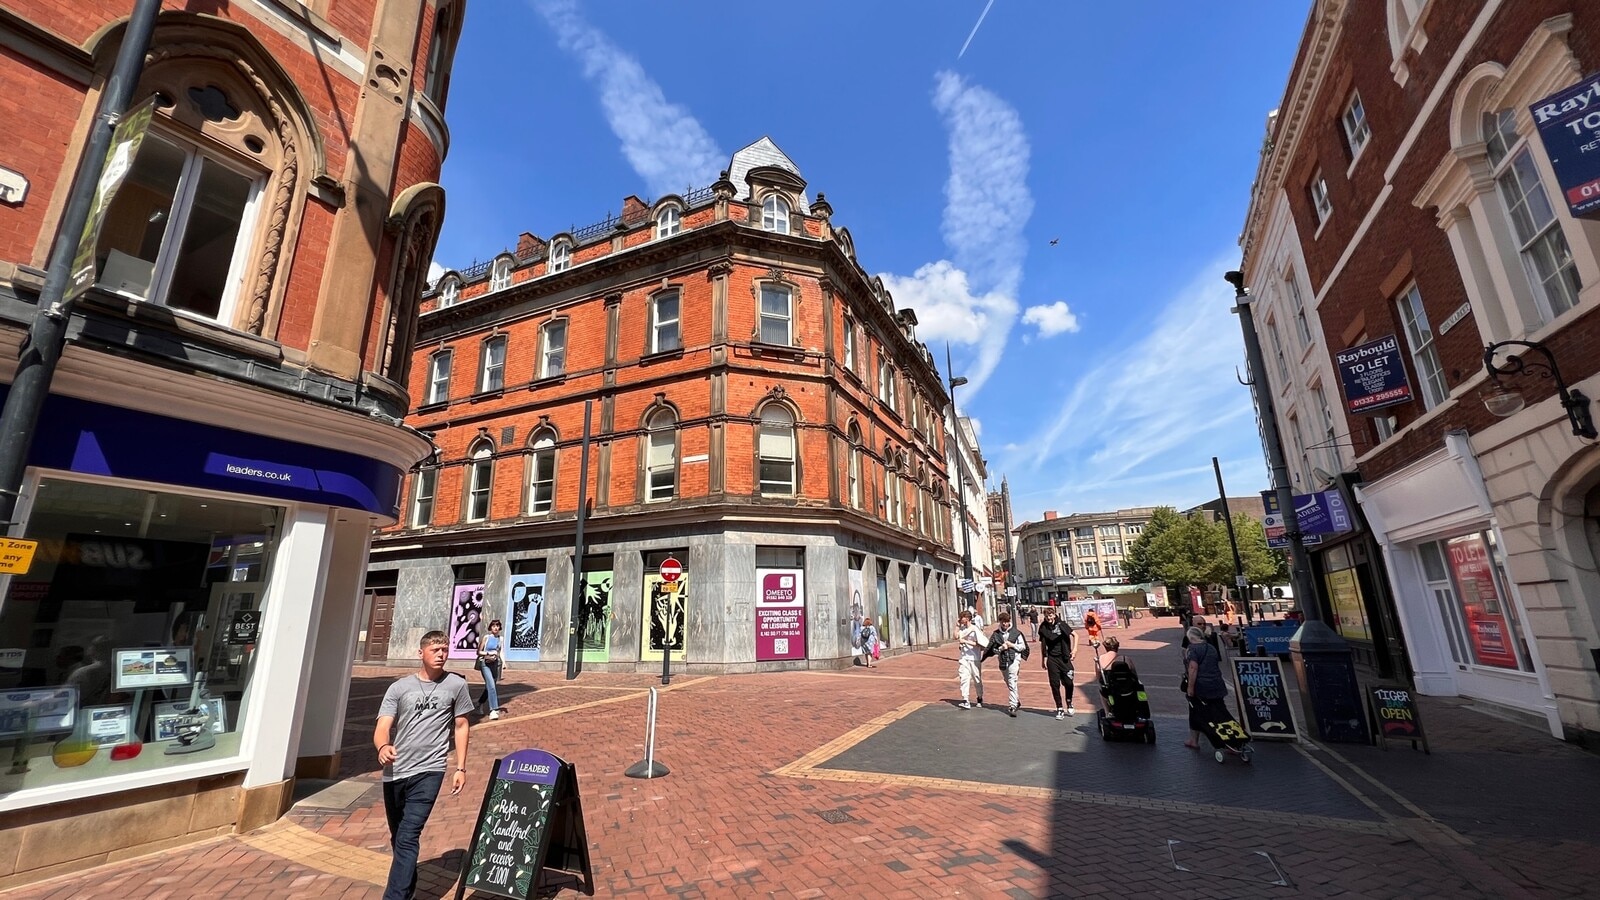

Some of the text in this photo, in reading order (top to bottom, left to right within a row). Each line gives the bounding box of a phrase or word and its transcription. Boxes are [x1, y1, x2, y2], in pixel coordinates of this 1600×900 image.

[1337, 338, 1396, 364] Raybould
[1349, 356, 1389, 375] TO LET
[1354, 396, 1375, 406] 01332
[1376, 389, 1403, 401] 295555
[226, 463, 291, 481] leaders.co.uk
[1297, 504, 1321, 519] ADERS
[1329, 493, 1348, 528] TO LET
[8, 541, 33, 550] Zone
[3, 554, 22, 562] any
[1450, 544, 1482, 563] TO LET
[235, 622, 256, 630] BEST
[1238, 662, 1272, 674] FISH
[1240, 674, 1279, 687] MARKET
[1247, 686, 1280, 699] OPEN
[1374, 689, 1411, 702] TIGER
[414, 702, 438, 711] MAX
[1380, 707, 1413, 721] OPEN
[507, 759, 550, 775] L LEADERS
[499, 799, 527, 822] Refer a
[492, 819, 531, 841] landlord
[497, 839, 514, 852] and
[488, 852, 515, 867] receive
[486, 865, 510, 888] £100!
